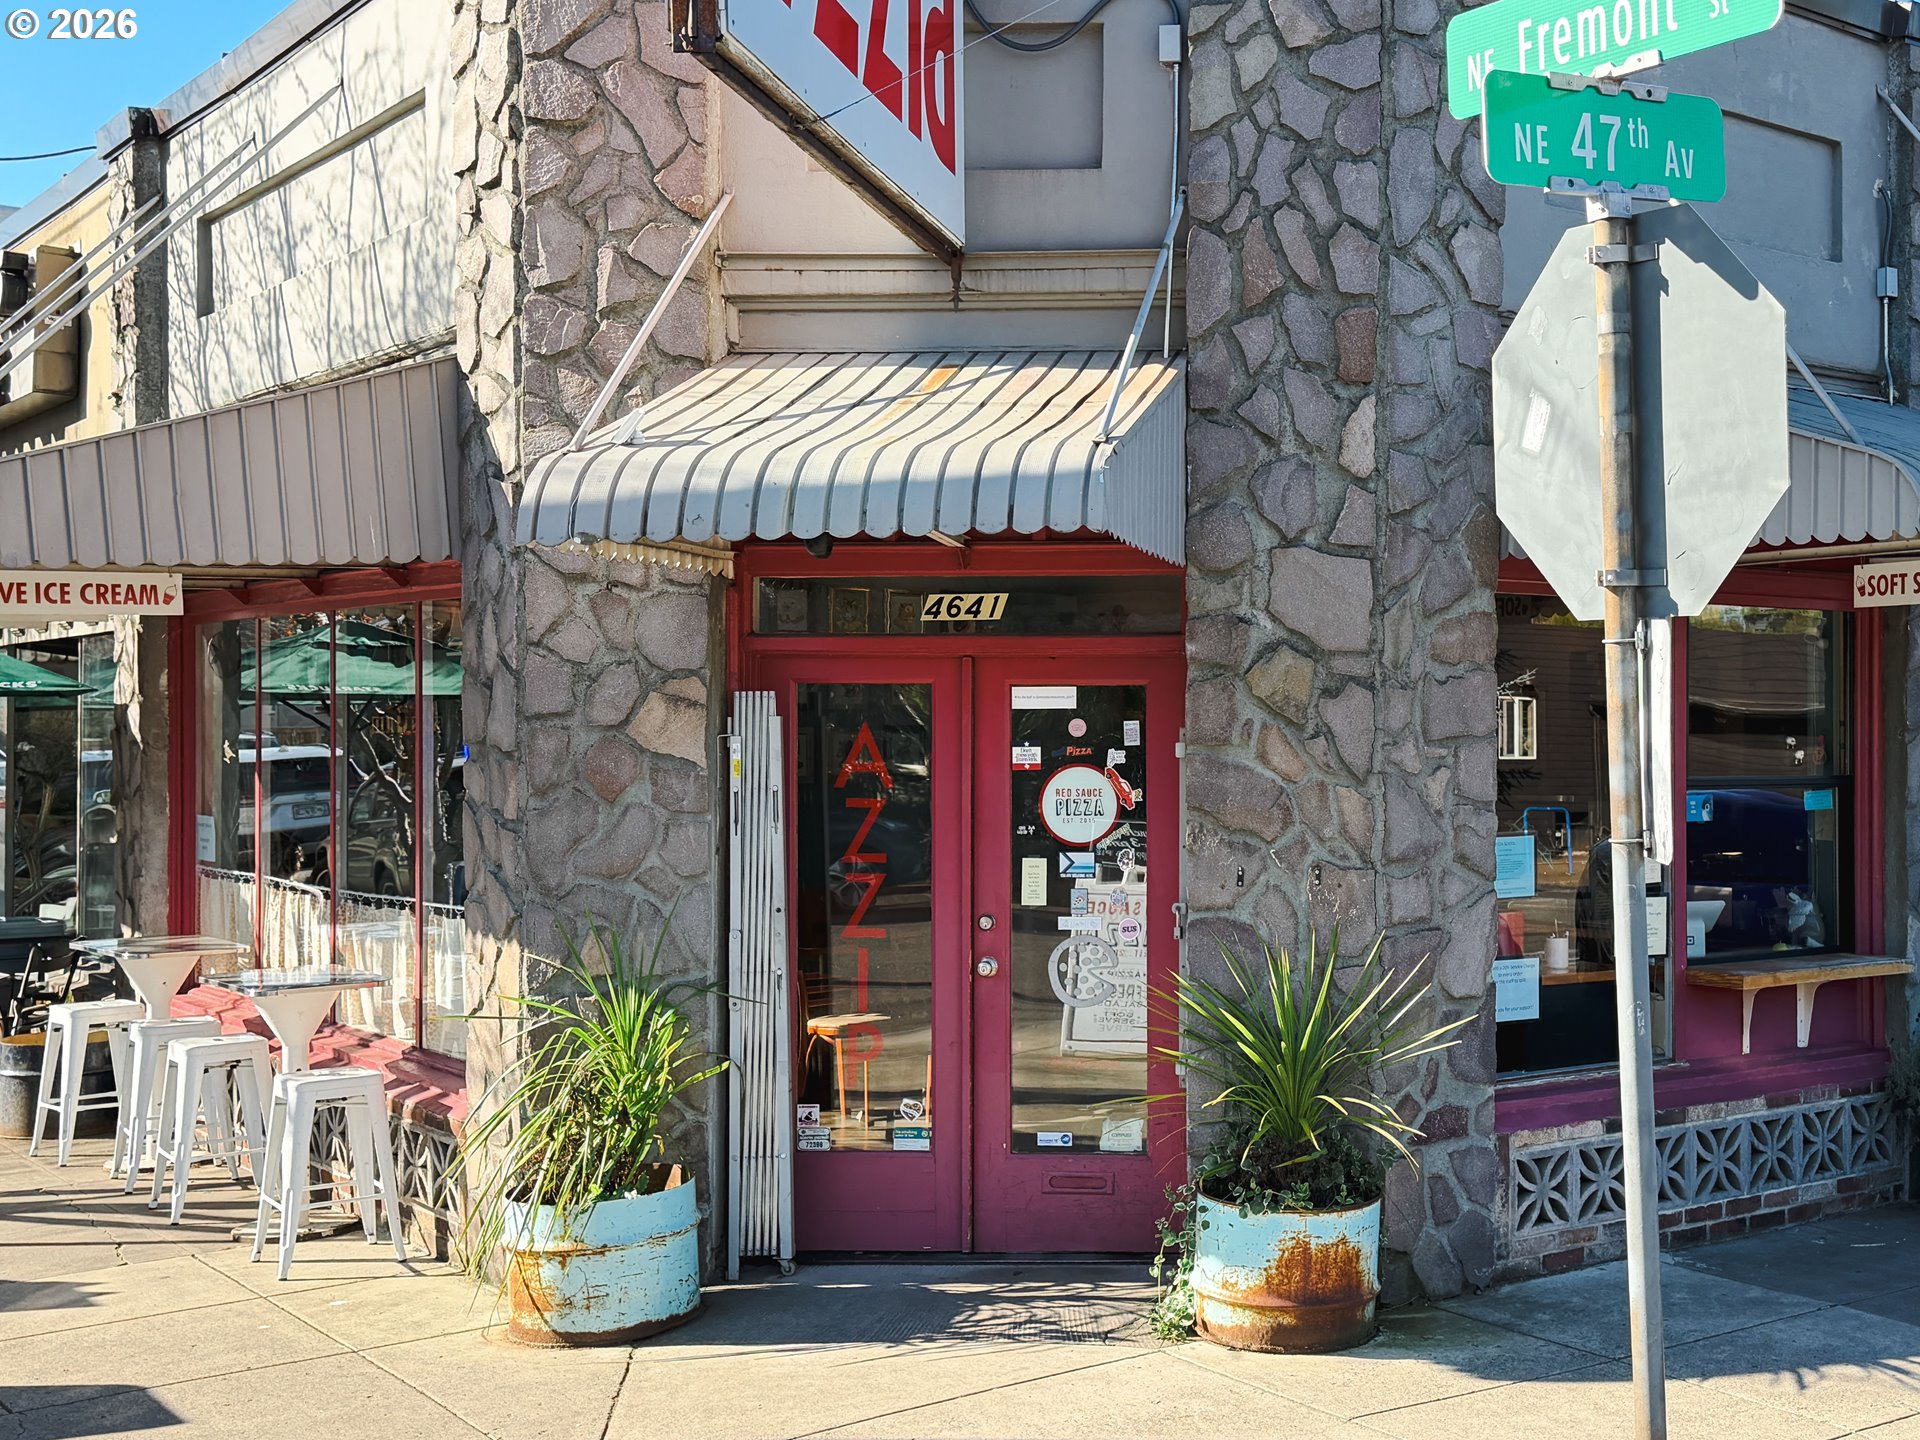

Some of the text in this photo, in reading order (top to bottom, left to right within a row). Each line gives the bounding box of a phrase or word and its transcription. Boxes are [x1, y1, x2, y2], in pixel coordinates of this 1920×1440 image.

[1517, 0, 1679, 73] Fremont
[1514, 122, 1550, 165] NE
[1571, 113, 1649, 172] 47th
[34, 582, 71, 604] ICE
[79, 583, 160, 605] CREAM
[1867, 573, 1908, 597] SOFT
[924, 595, 1000, 619] 4641
[1055, 788, 1103, 797] RED SAUCE
[1055, 798, 1105, 816] PIZZA
[1121, 925, 1138, 934] SUS
